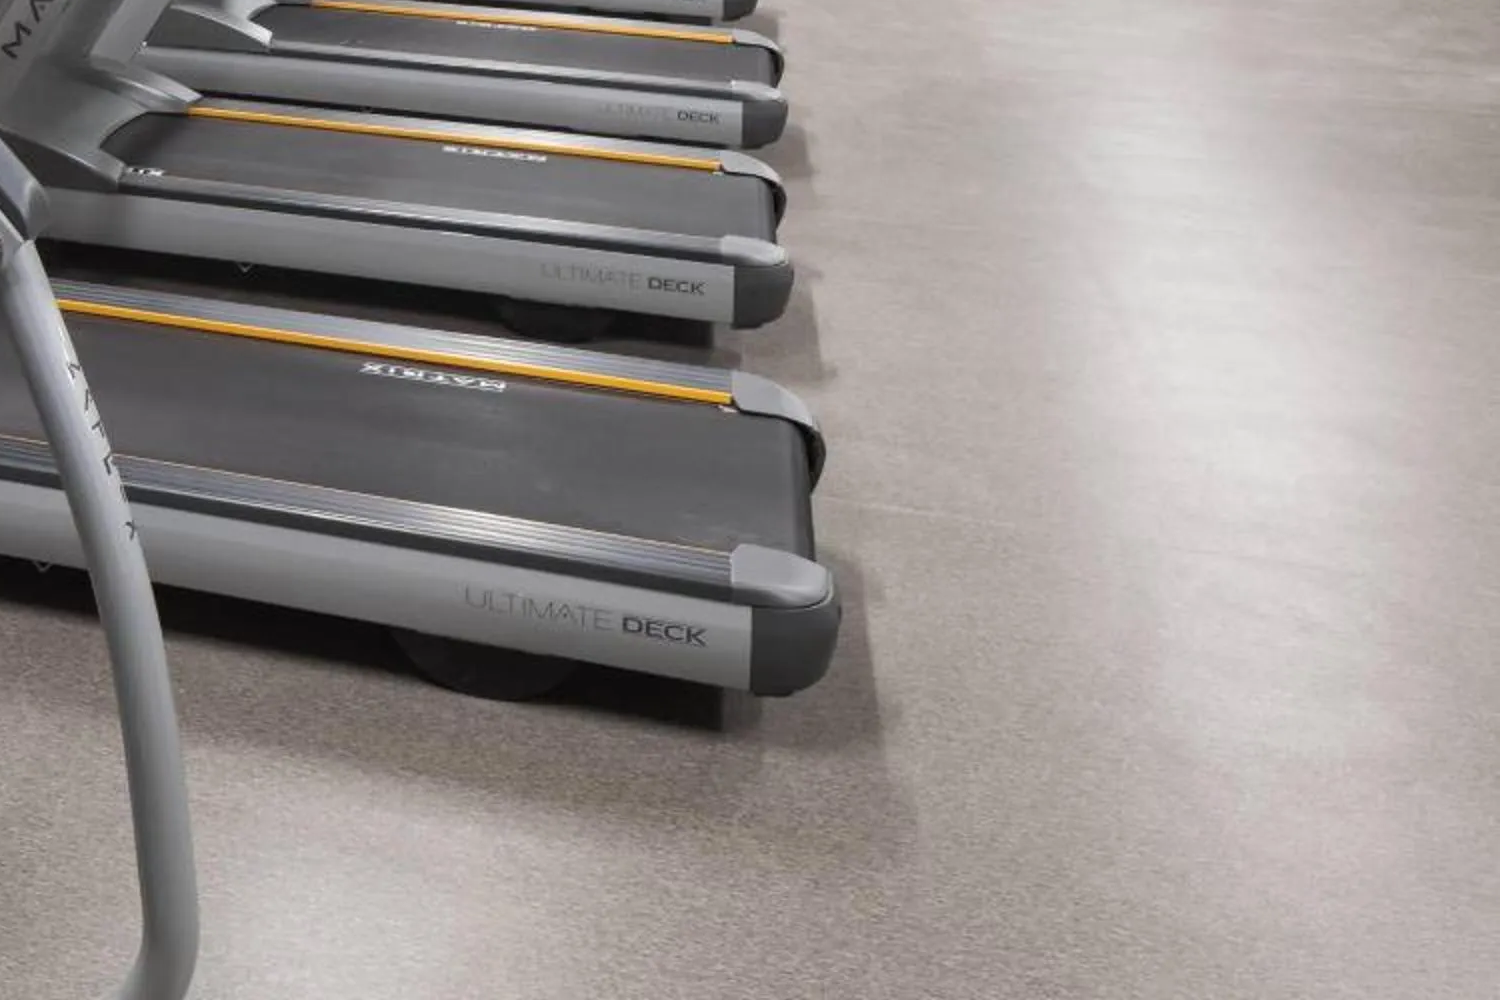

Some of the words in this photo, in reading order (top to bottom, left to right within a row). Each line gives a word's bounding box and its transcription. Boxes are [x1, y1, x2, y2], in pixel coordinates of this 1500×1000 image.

[676, 109, 721, 125] DECK
[541, 262, 643, 290] ULTIMATE
[647, 275, 707, 296] DECK
[464, 584, 614, 632] ULTIMATE
[621, 615, 708, 647] DECK
